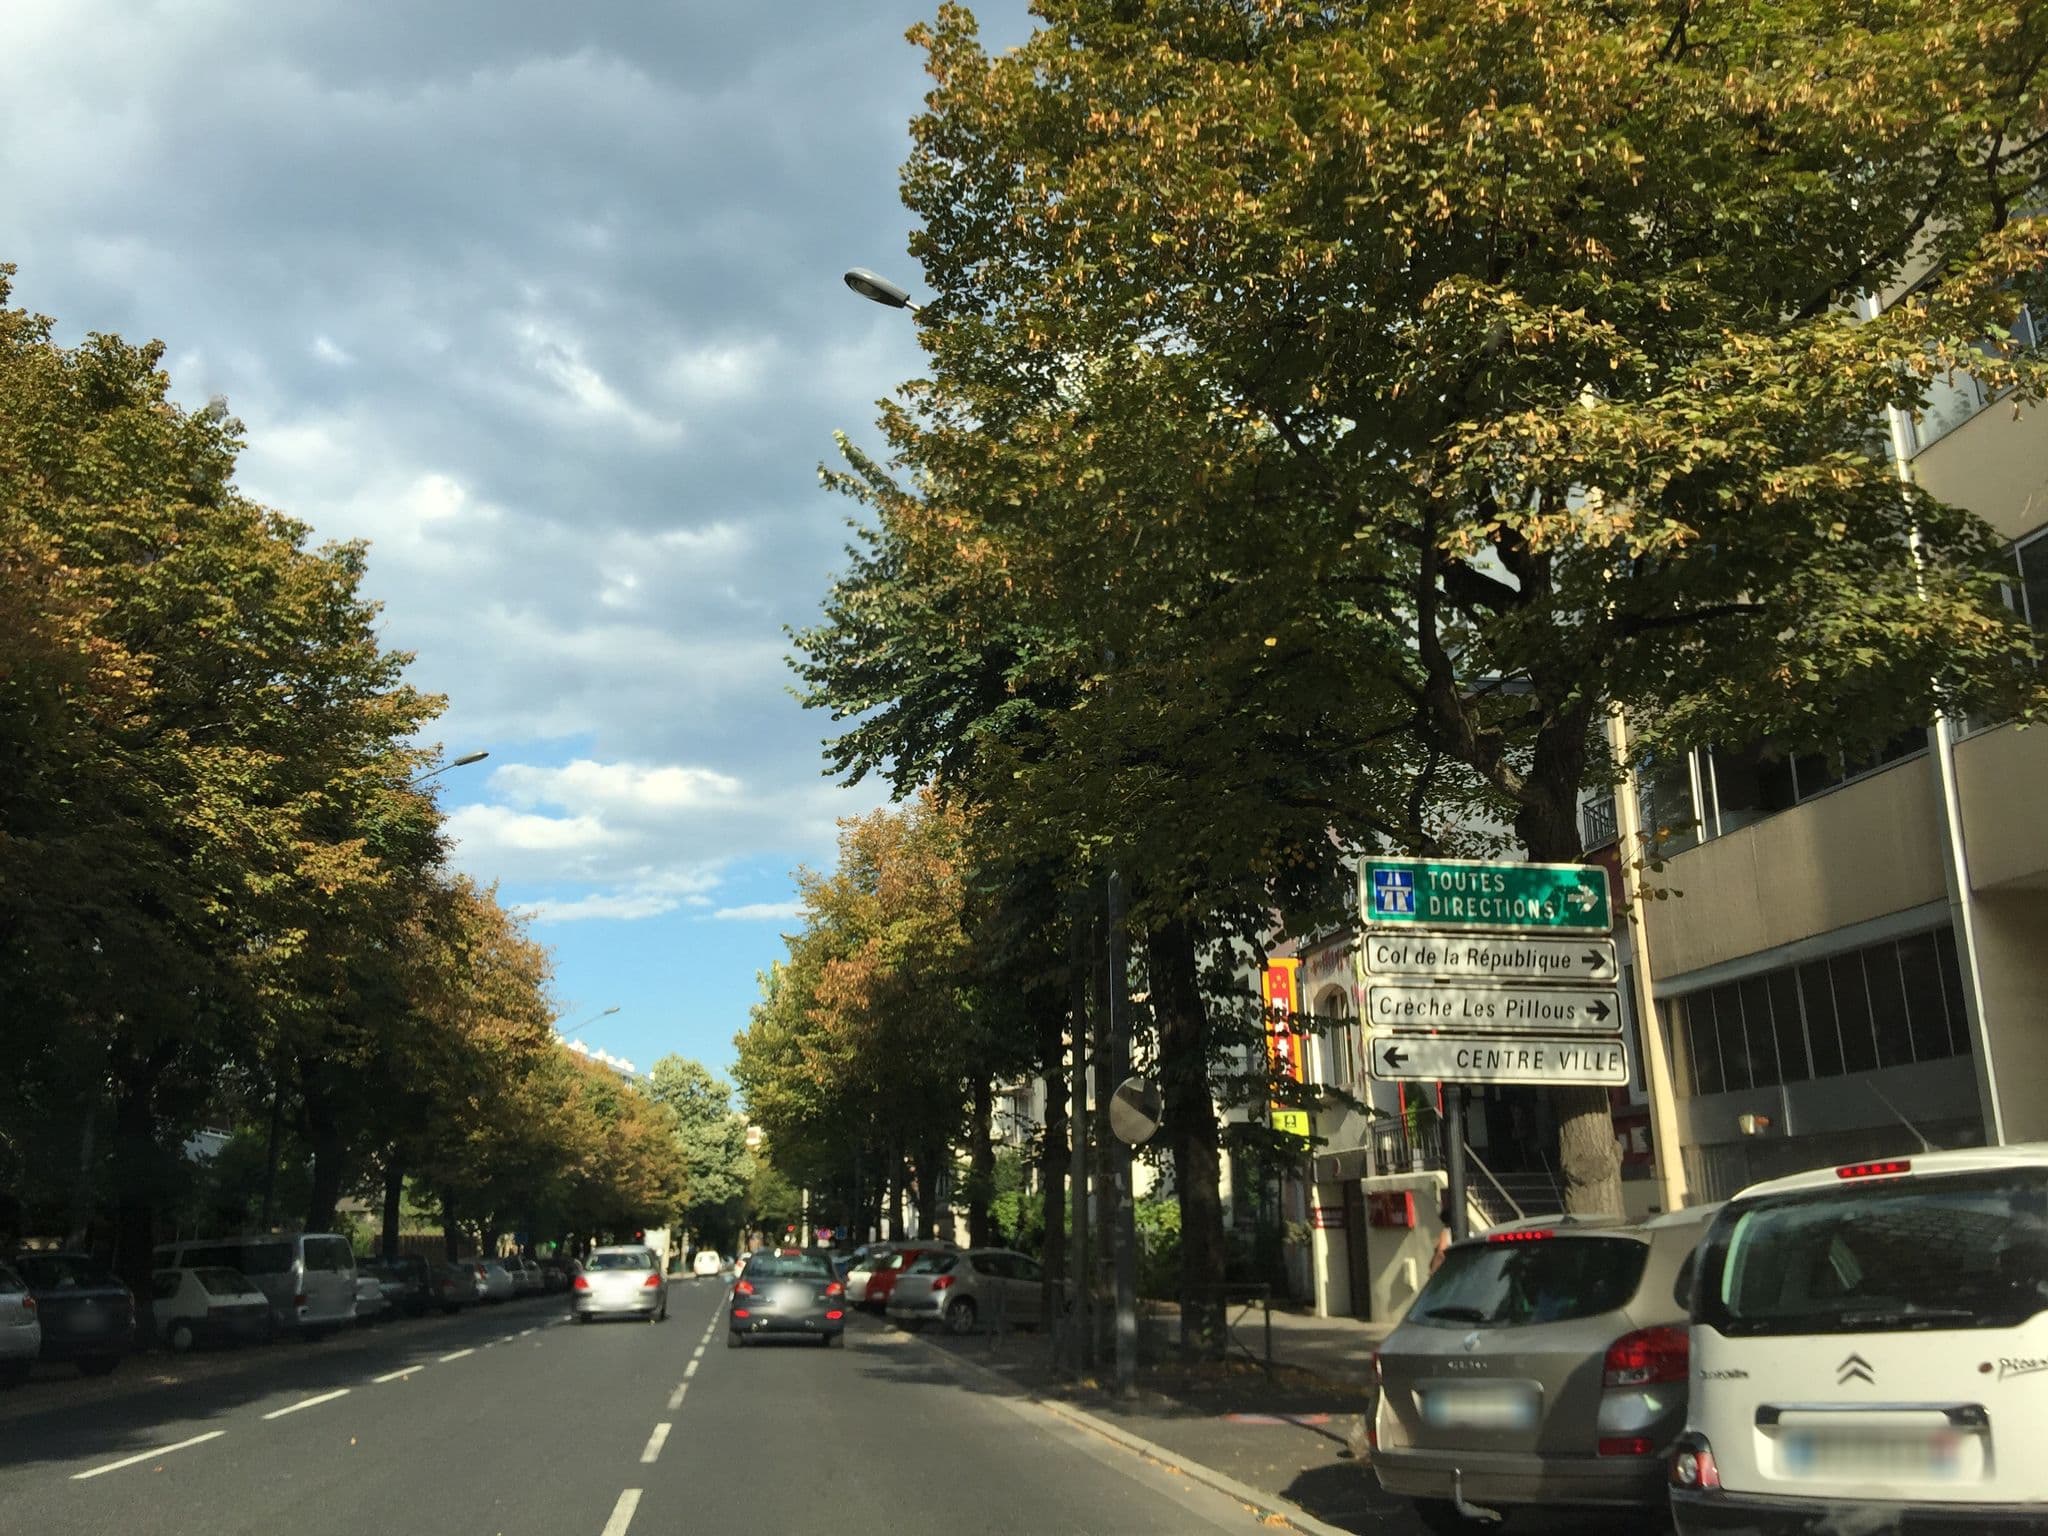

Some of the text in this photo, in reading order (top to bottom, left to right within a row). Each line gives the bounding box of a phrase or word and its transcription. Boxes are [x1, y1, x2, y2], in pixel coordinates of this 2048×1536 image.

[1428, 871, 1505, 892] TOUTES
[1429, 896, 1555, 919] DIRECTIONS
[1377, 945, 1571, 973] Col de la République
[1380, 998, 1576, 1020] Crèche Les Pillous
[1457, 1050, 1618, 1071] CENTRE VILLE
